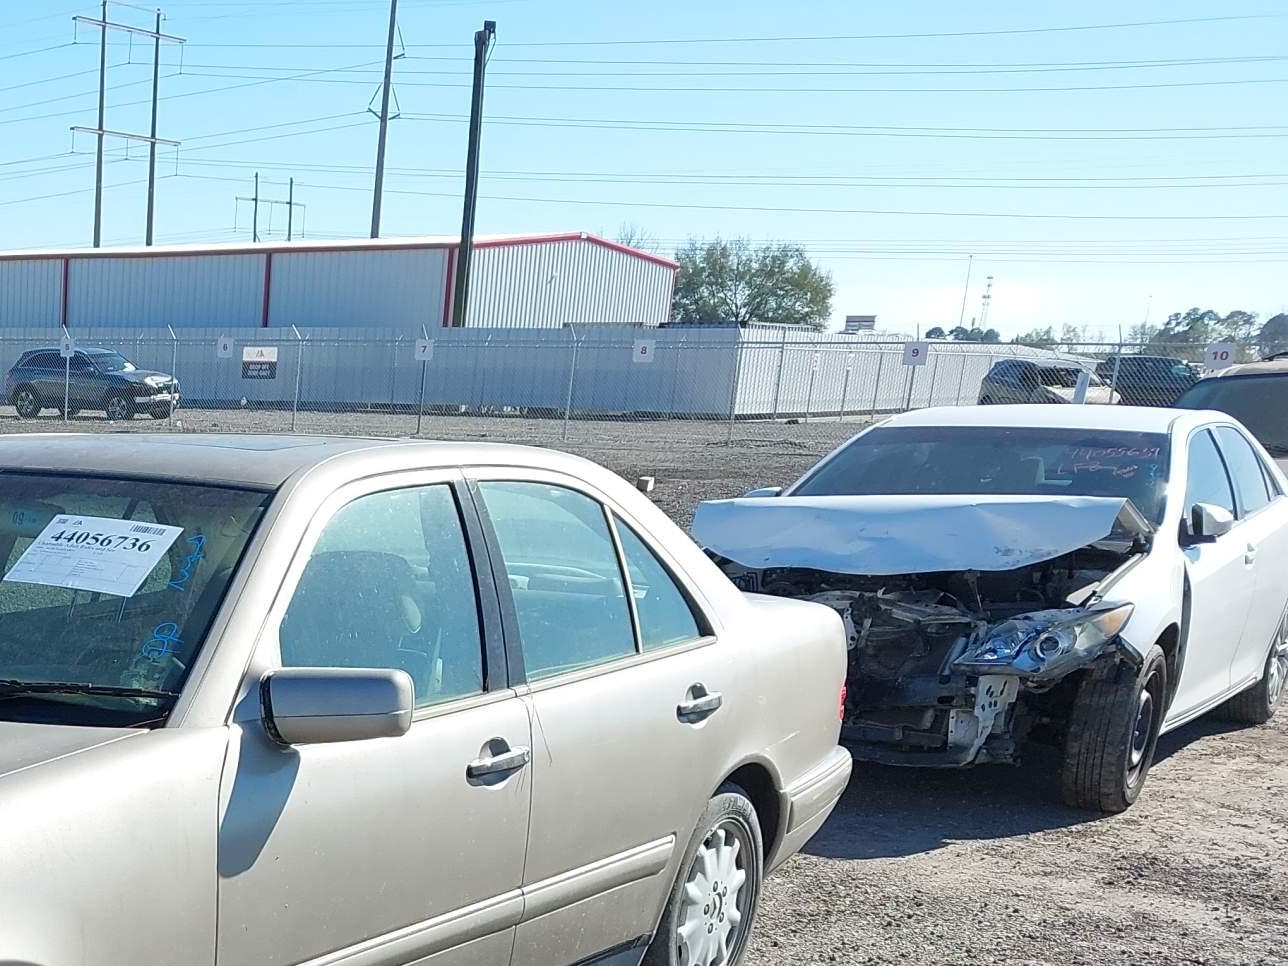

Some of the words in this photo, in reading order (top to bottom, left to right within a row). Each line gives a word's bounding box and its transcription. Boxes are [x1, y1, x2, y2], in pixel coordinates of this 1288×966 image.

[421, 345, 427, 353] 7
[640, 346, 647, 355] 8
[911, 348, 919, 357] 9
[1212, 351, 1229, 361] 10
[51, 529, 157, 553] 44056736
